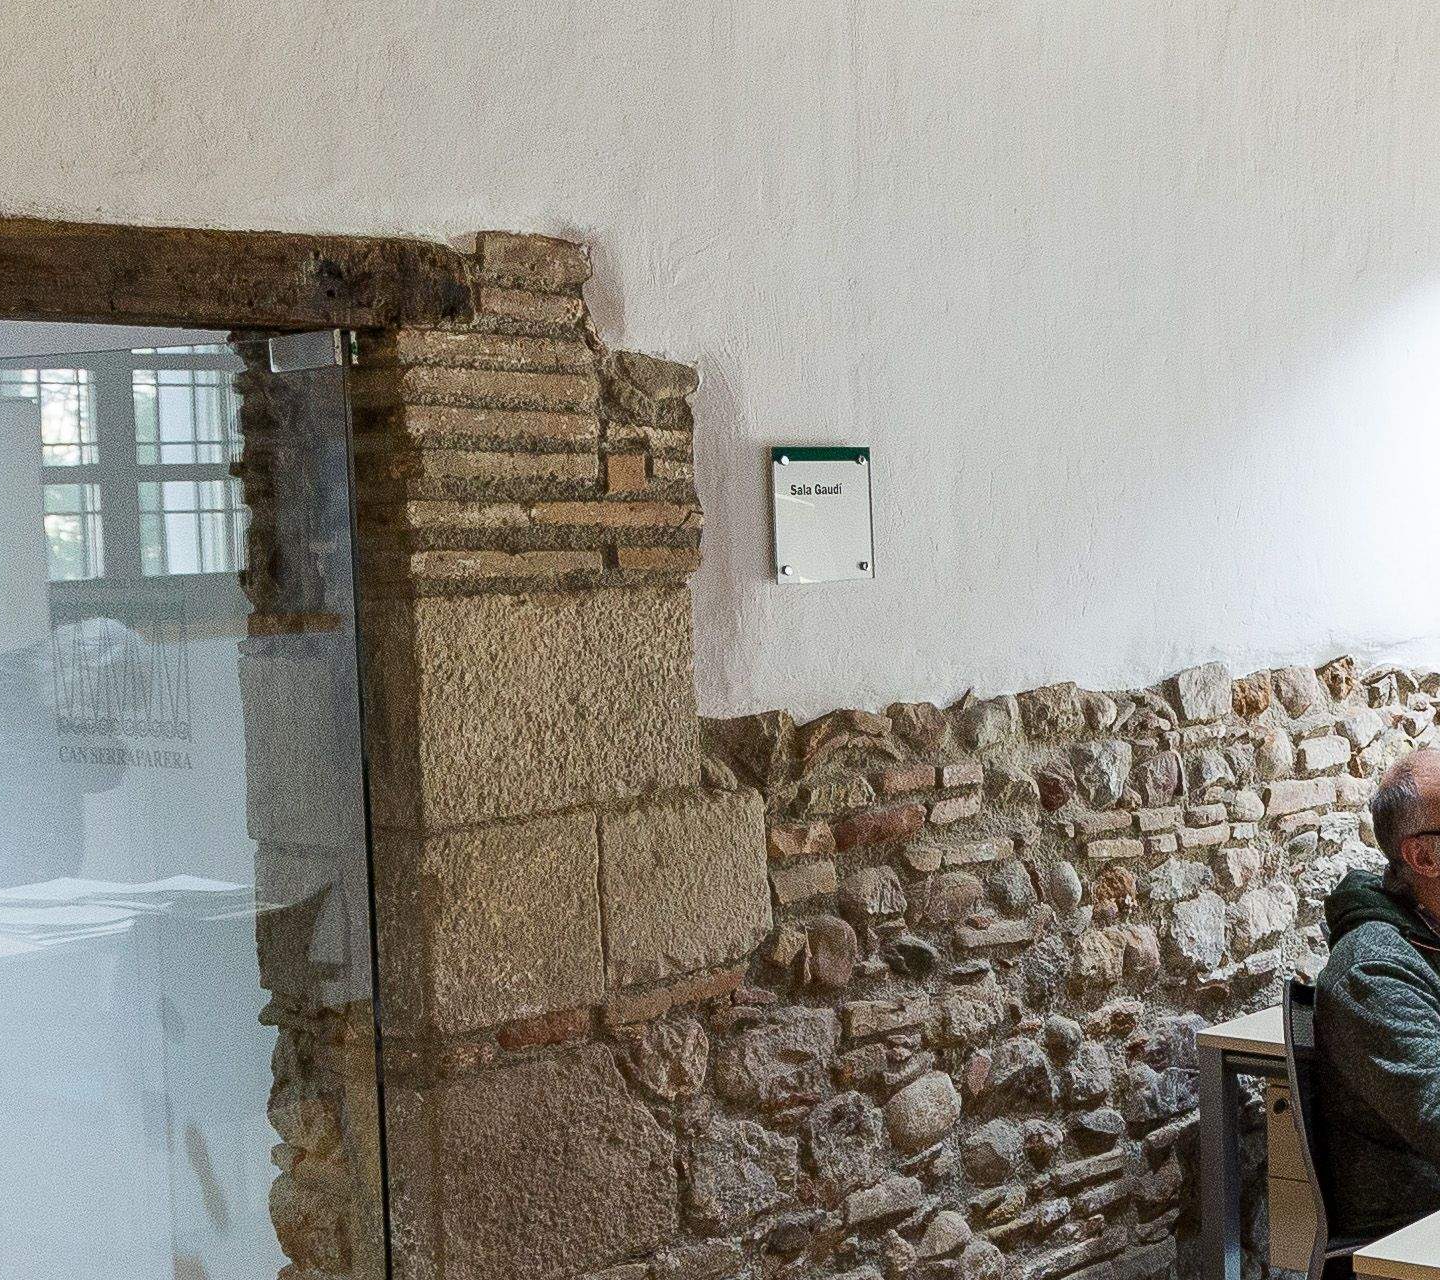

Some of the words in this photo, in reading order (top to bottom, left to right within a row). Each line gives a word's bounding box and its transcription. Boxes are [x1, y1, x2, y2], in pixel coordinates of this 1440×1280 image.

[790, 484, 812, 496] Sala
[814, 482, 843, 495] Gaudí
[59, 746, 88, 763] CAN
